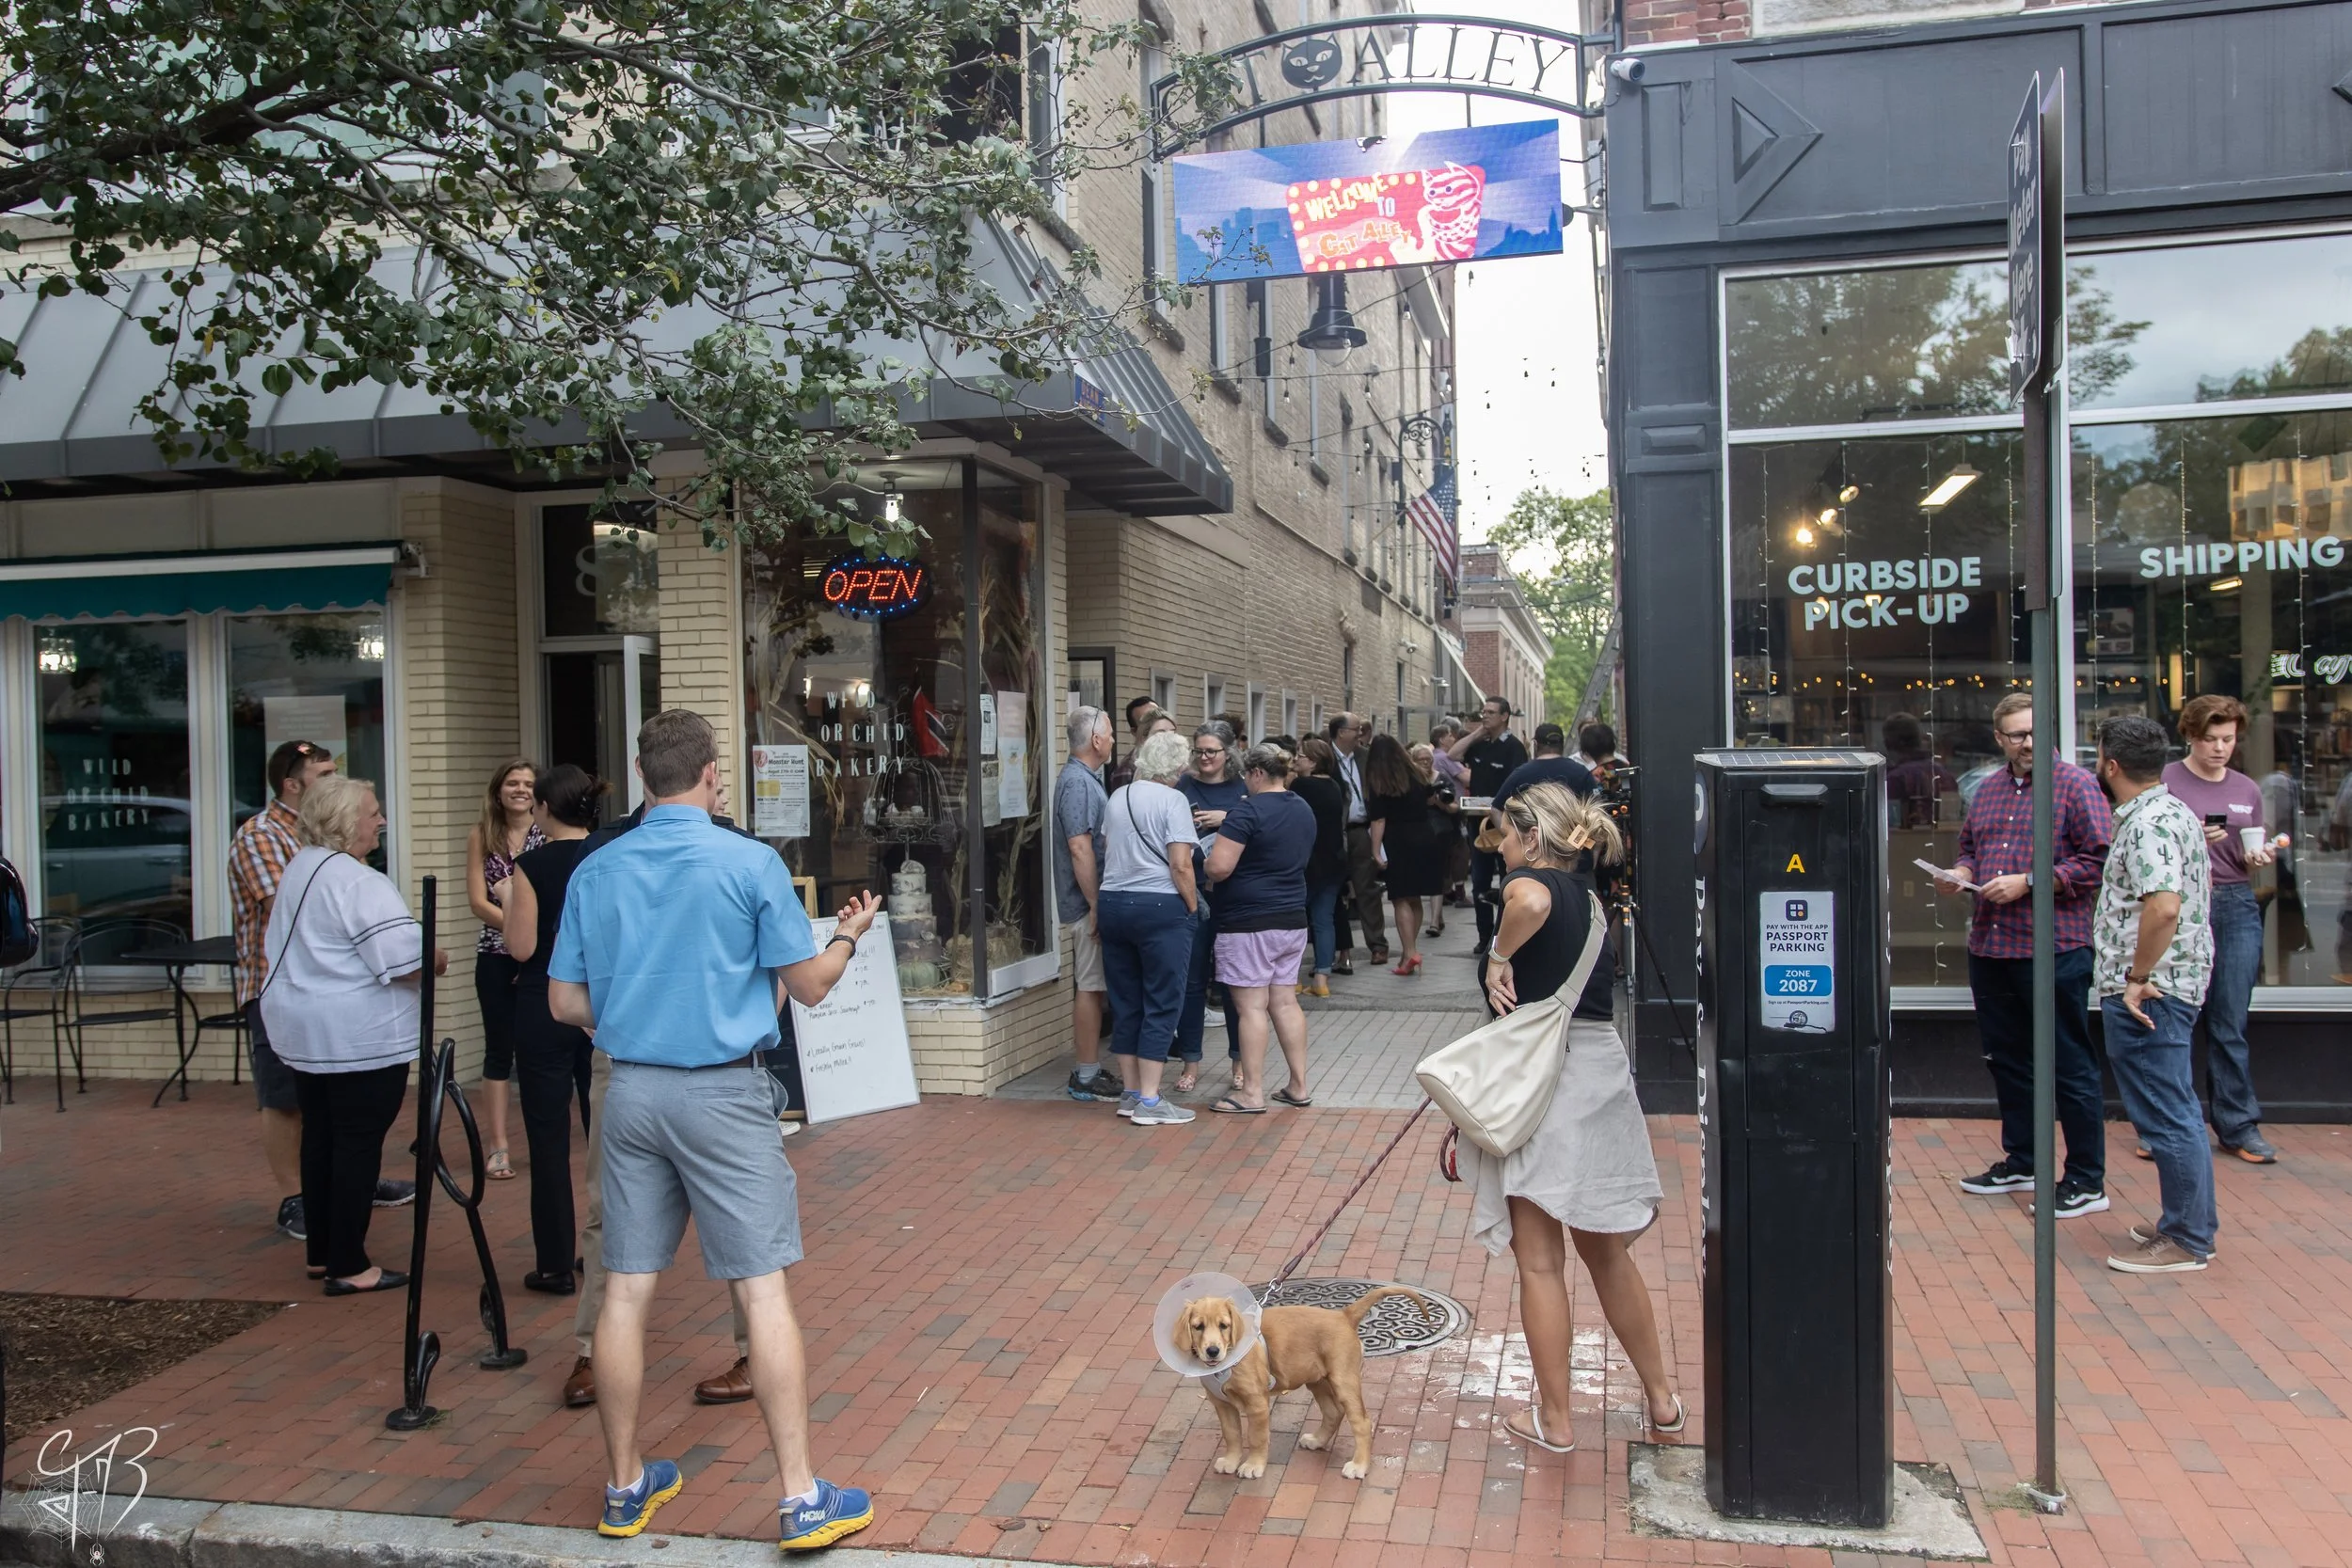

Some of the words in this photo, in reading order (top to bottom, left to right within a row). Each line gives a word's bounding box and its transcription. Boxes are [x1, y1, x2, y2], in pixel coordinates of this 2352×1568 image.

[1161, 50, 1267, 132] CT
[1346, 25, 1574, 92] ALLEY
[1304, 171, 1389, 222] WELCOME
[1376, 196, 1395, 217] TO
[2010, 174, 2036, 261] Meter
[1319, 232, 1358, 258] CAT
[2011, 252, 2034, 320] Here
[2139, 535, 2344, 578] SHIPPING
[824, 569, 922, 601] OPEN
[1788, 557, 1981, 595] CURBSIDE
[1804, 593, 1970, 631] PICK-UP
[820, 722, 904, 742] ORCHID
[83, 757, 132, 776] WILD
[816, 754, 904, 777] BAKERY
[67, 784, 149, 804] ORCHID
[68, 808, 149, 832] BAKERY
[1786, 854, 1805, 873] A
[1766, 932, 1829, 941] PASSPORT
[1770, 942, 1825, 952] PARKING
[1778, 979, 1818, 992] 2087
[800, 1509, 826, 1522] HOKA
